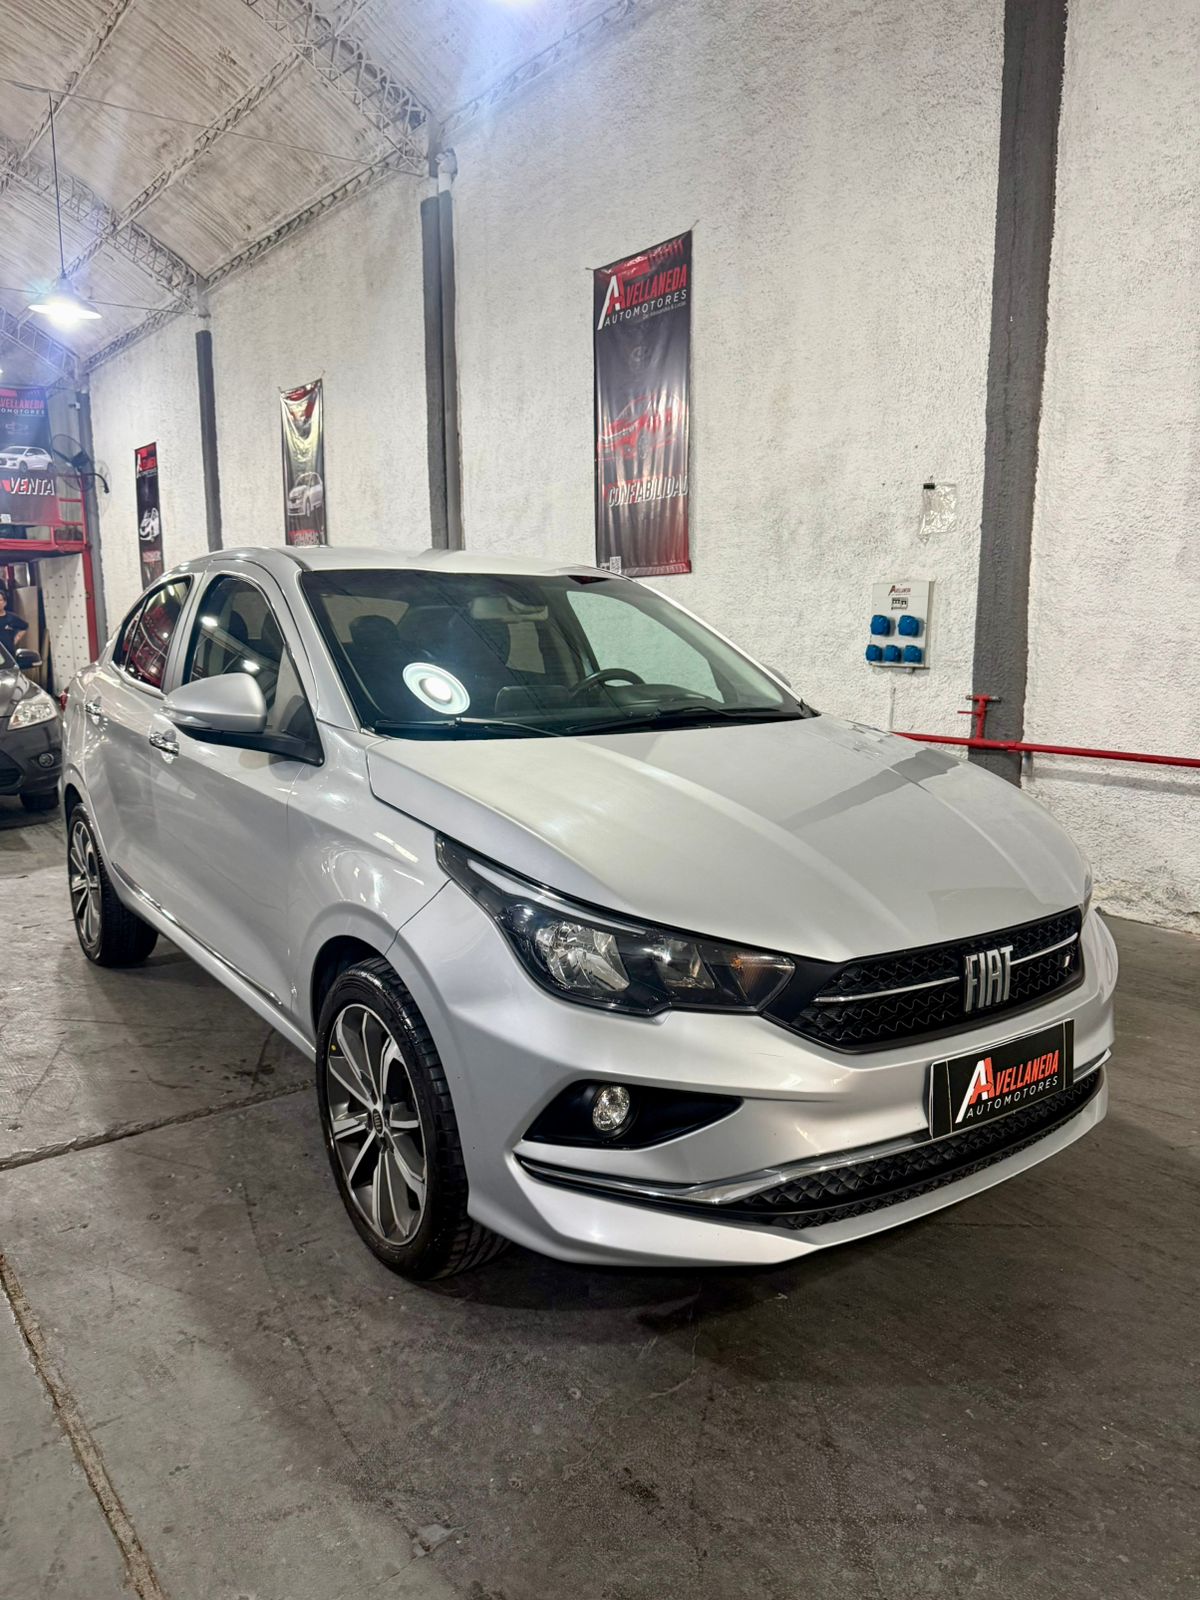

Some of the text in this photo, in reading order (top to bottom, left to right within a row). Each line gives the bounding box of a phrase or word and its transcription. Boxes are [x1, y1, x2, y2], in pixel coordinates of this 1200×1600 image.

[597, 263, 687, 330] AVELLANEDA
[604, 289, 687, 327] AUTOMOTORES
[0, 398, 45, 410] VELLANEDA
[10, 477, 56, 496] VENTA
[965, 945, 1013, 1012] FIAT
[955, 1049, 1060, 1124] AVELLANEDA
[966, 1075, 1059, 1119] AUTOMOTORES
